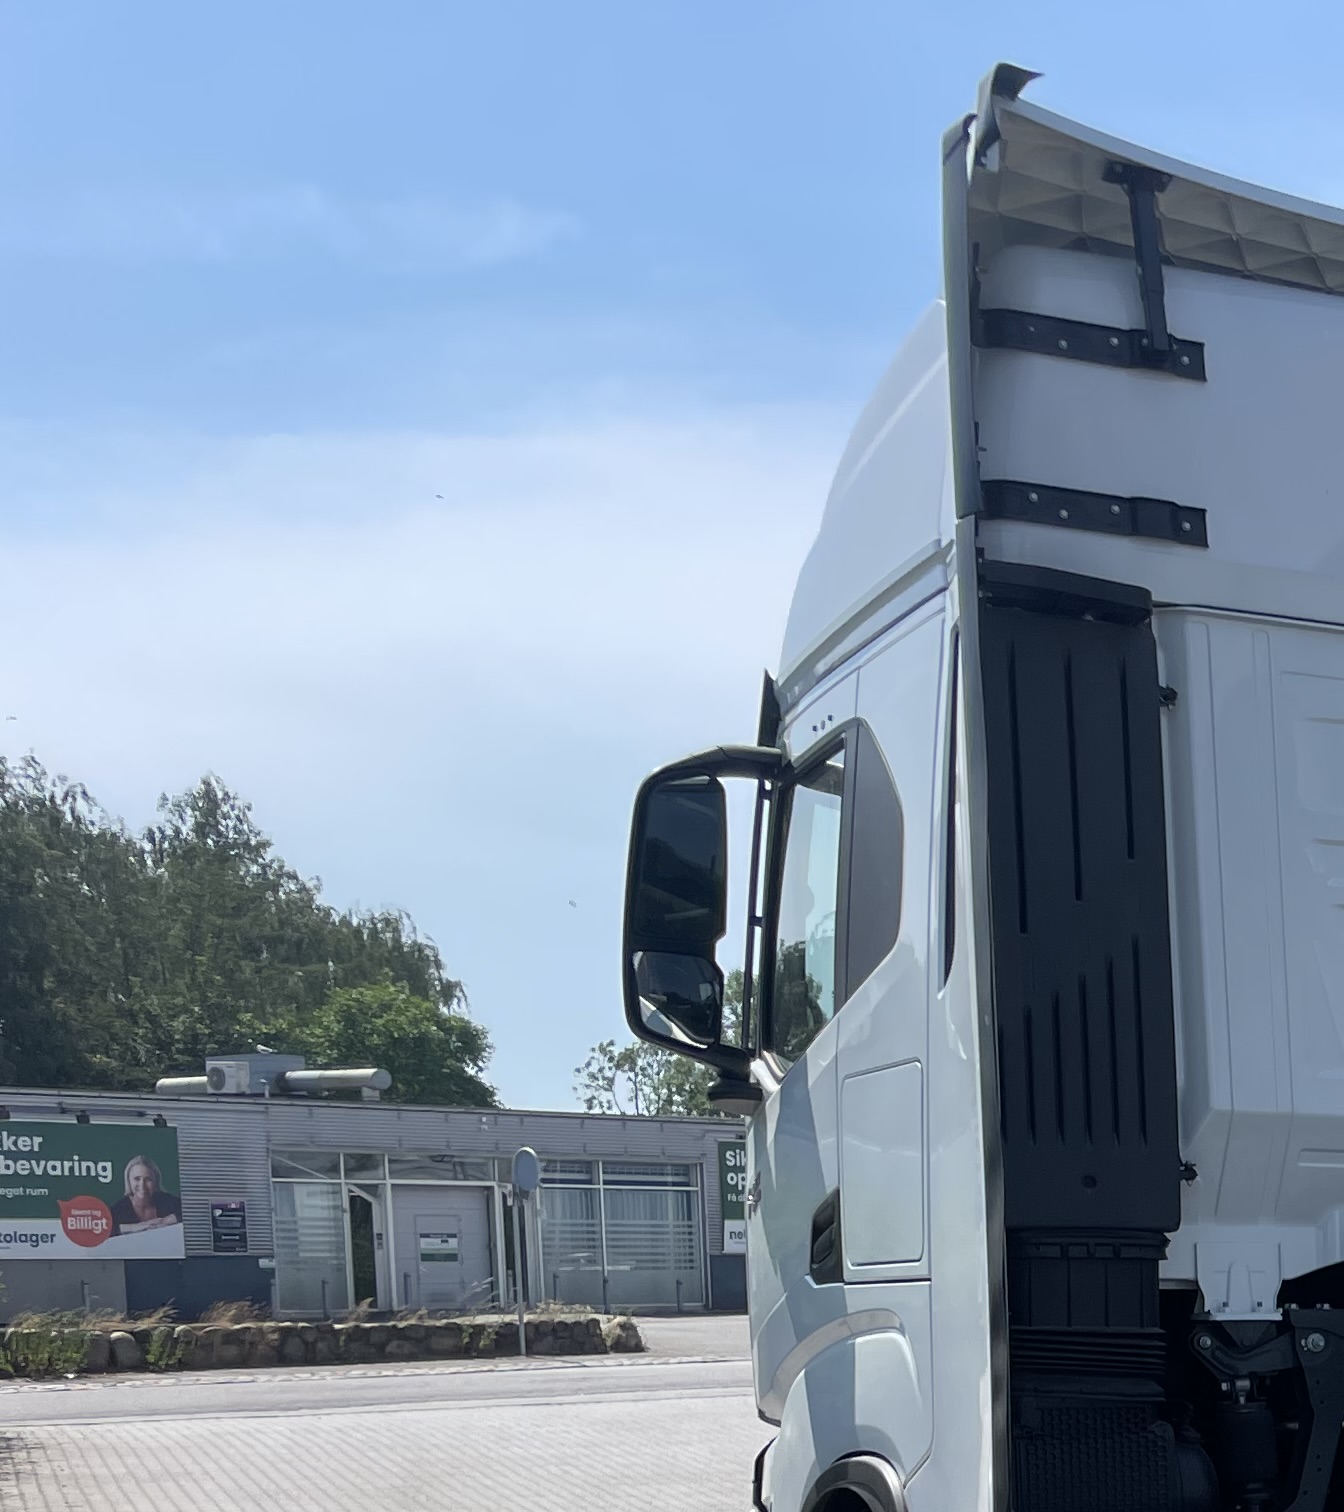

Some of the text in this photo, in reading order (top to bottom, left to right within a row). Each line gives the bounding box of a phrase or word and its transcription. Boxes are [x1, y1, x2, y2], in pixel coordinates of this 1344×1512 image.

[0, 1131, 43, 1152] ker
[0, 1154, 113, 1184] bevaring
[26, 1188, 49, 1196] rum
[67, 1217, 108, 1235] Billigt
